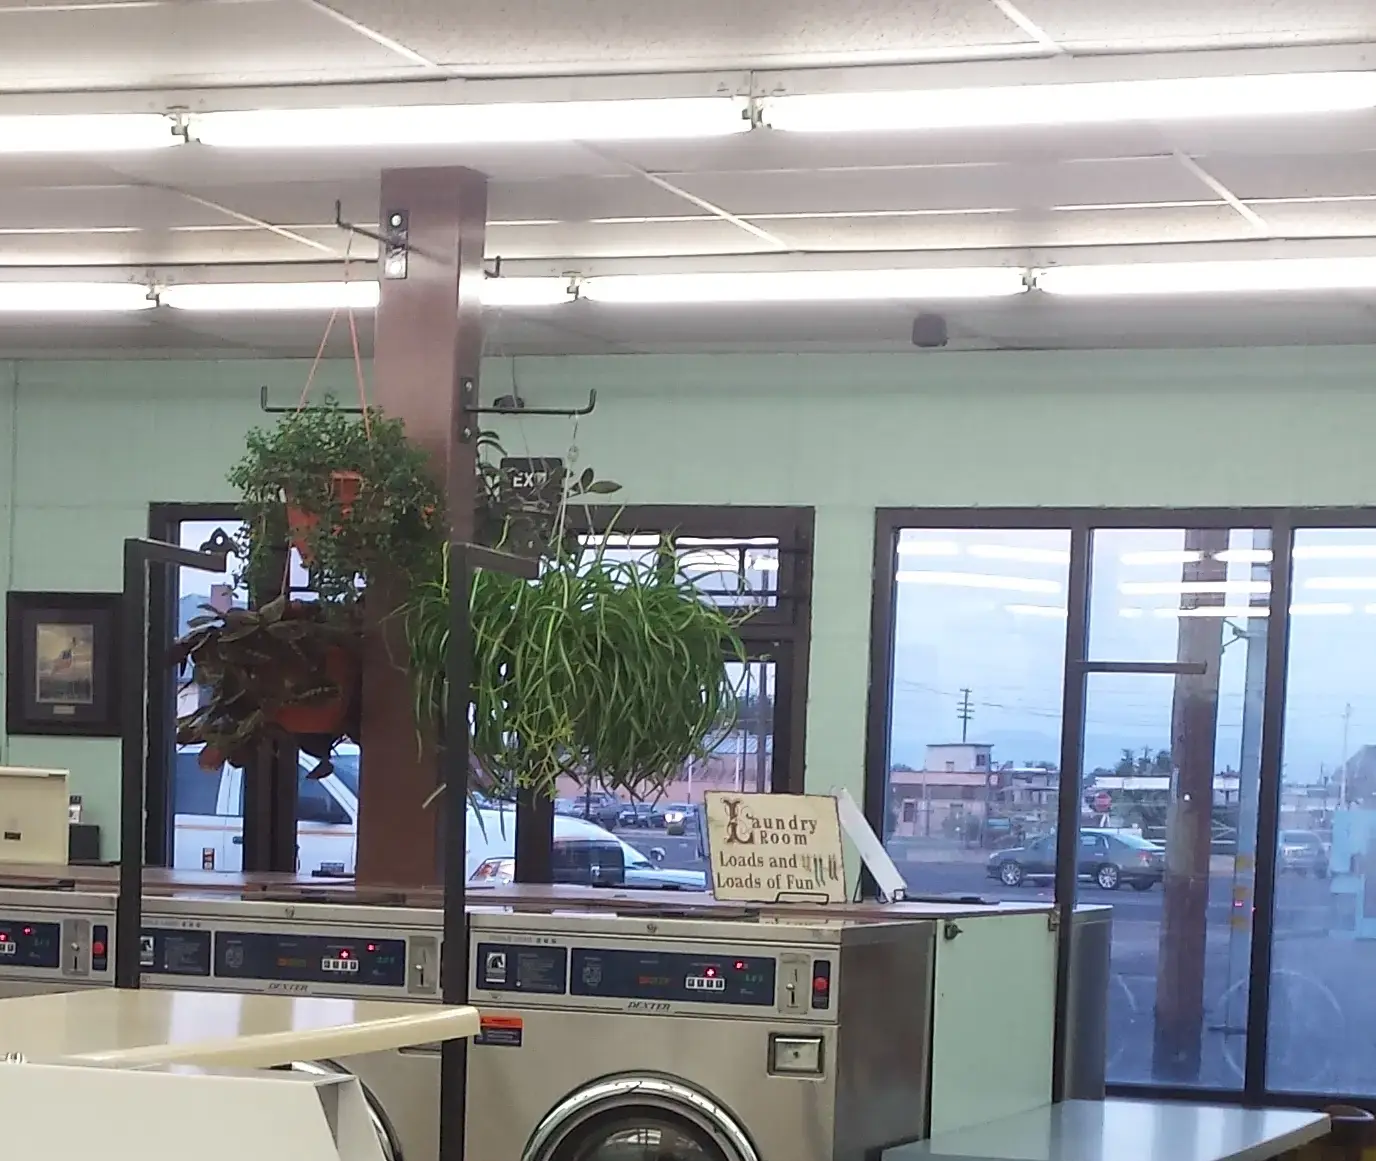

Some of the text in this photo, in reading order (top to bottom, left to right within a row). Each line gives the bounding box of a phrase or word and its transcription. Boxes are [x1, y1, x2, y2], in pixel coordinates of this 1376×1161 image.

[720, 797, 818, 845] Laundry
[760, 830, 807, 846] Room
[719, 851, 798, 869] Loads and
[716, 873, 814, 891] Loads of Fun
